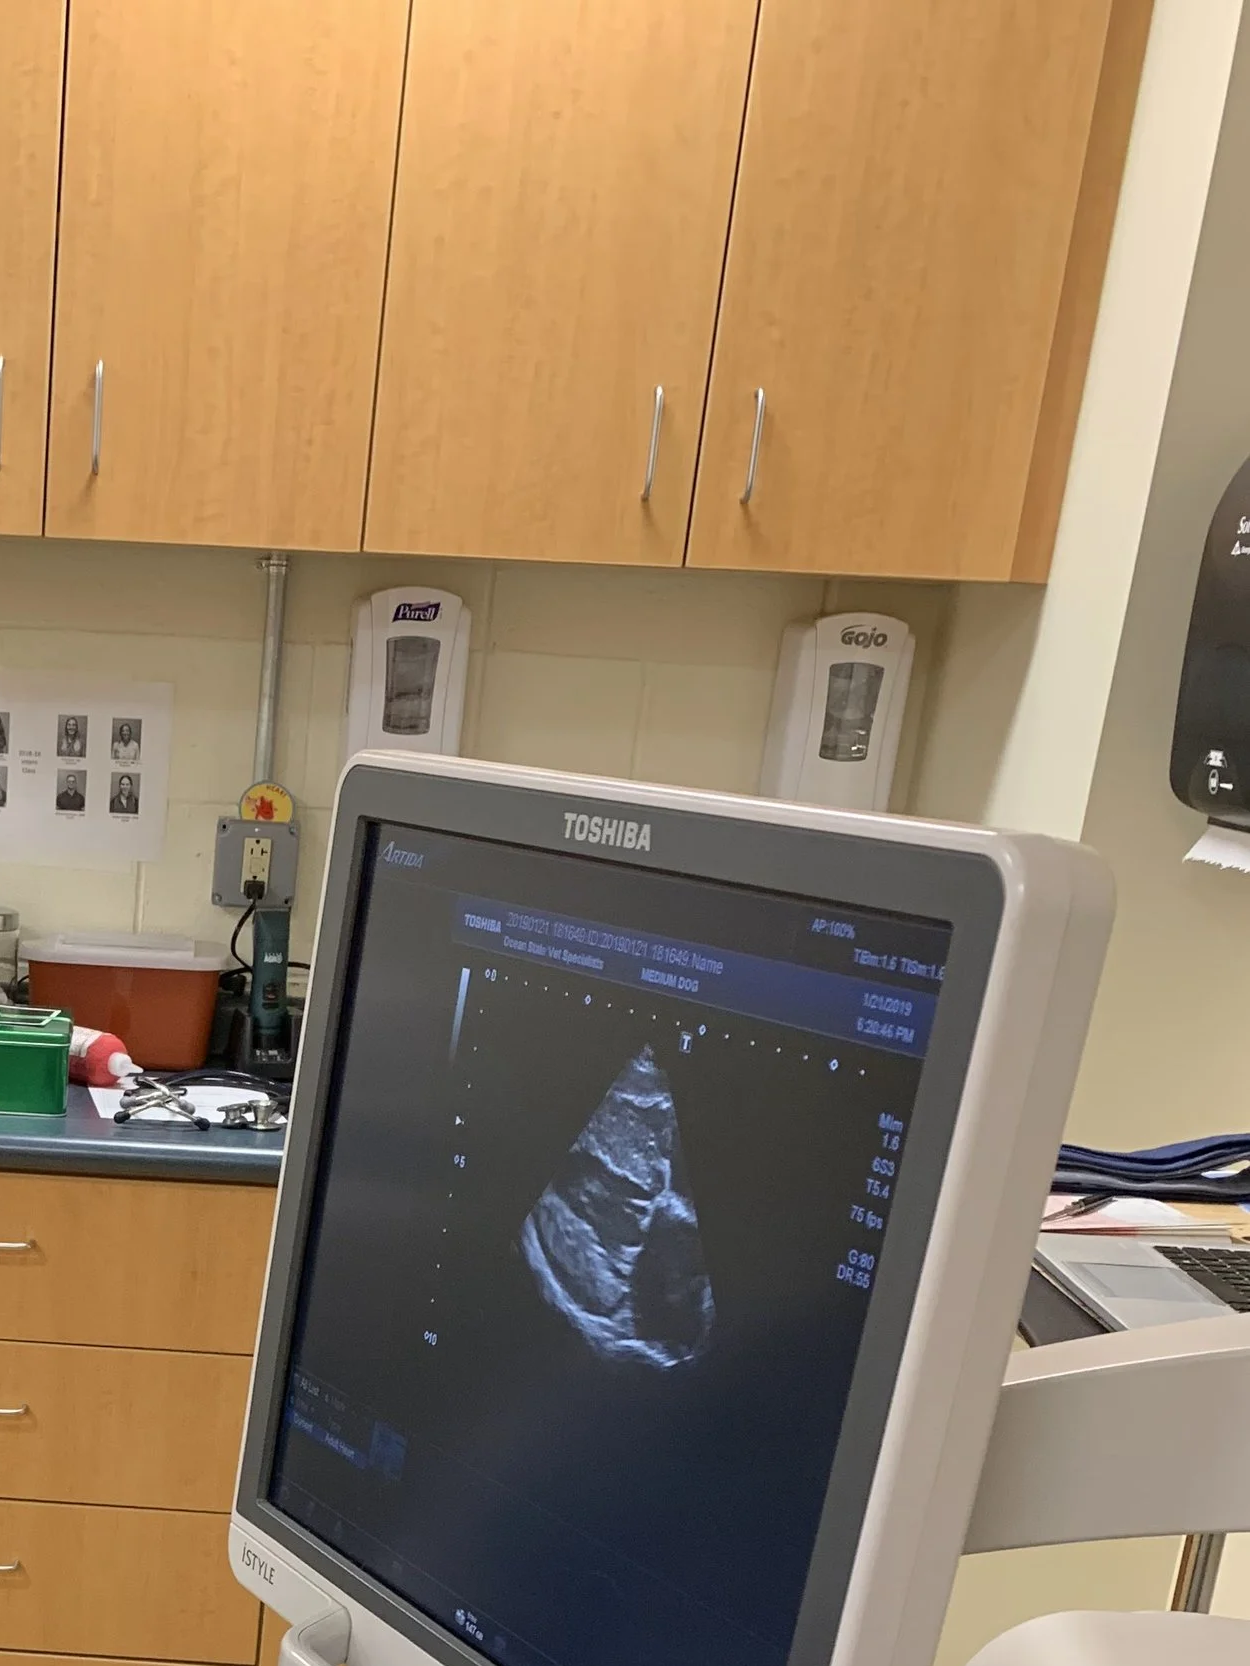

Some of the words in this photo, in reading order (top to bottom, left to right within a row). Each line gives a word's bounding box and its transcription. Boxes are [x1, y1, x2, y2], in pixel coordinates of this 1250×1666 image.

[398, 605, 435, 620] Purell
[564, 812, 651, 852] TOSHIBA
[464, 913, 501, 934] TOSHIBA
[640, 967, 677, 988] MEDIUM
[677, 976, 699, 992] DOG
[895, 1026, 915, 1044] PM
[865, 1211, 883, 1230] fps
[242, 1541, 275, 1585] iSTYLE
